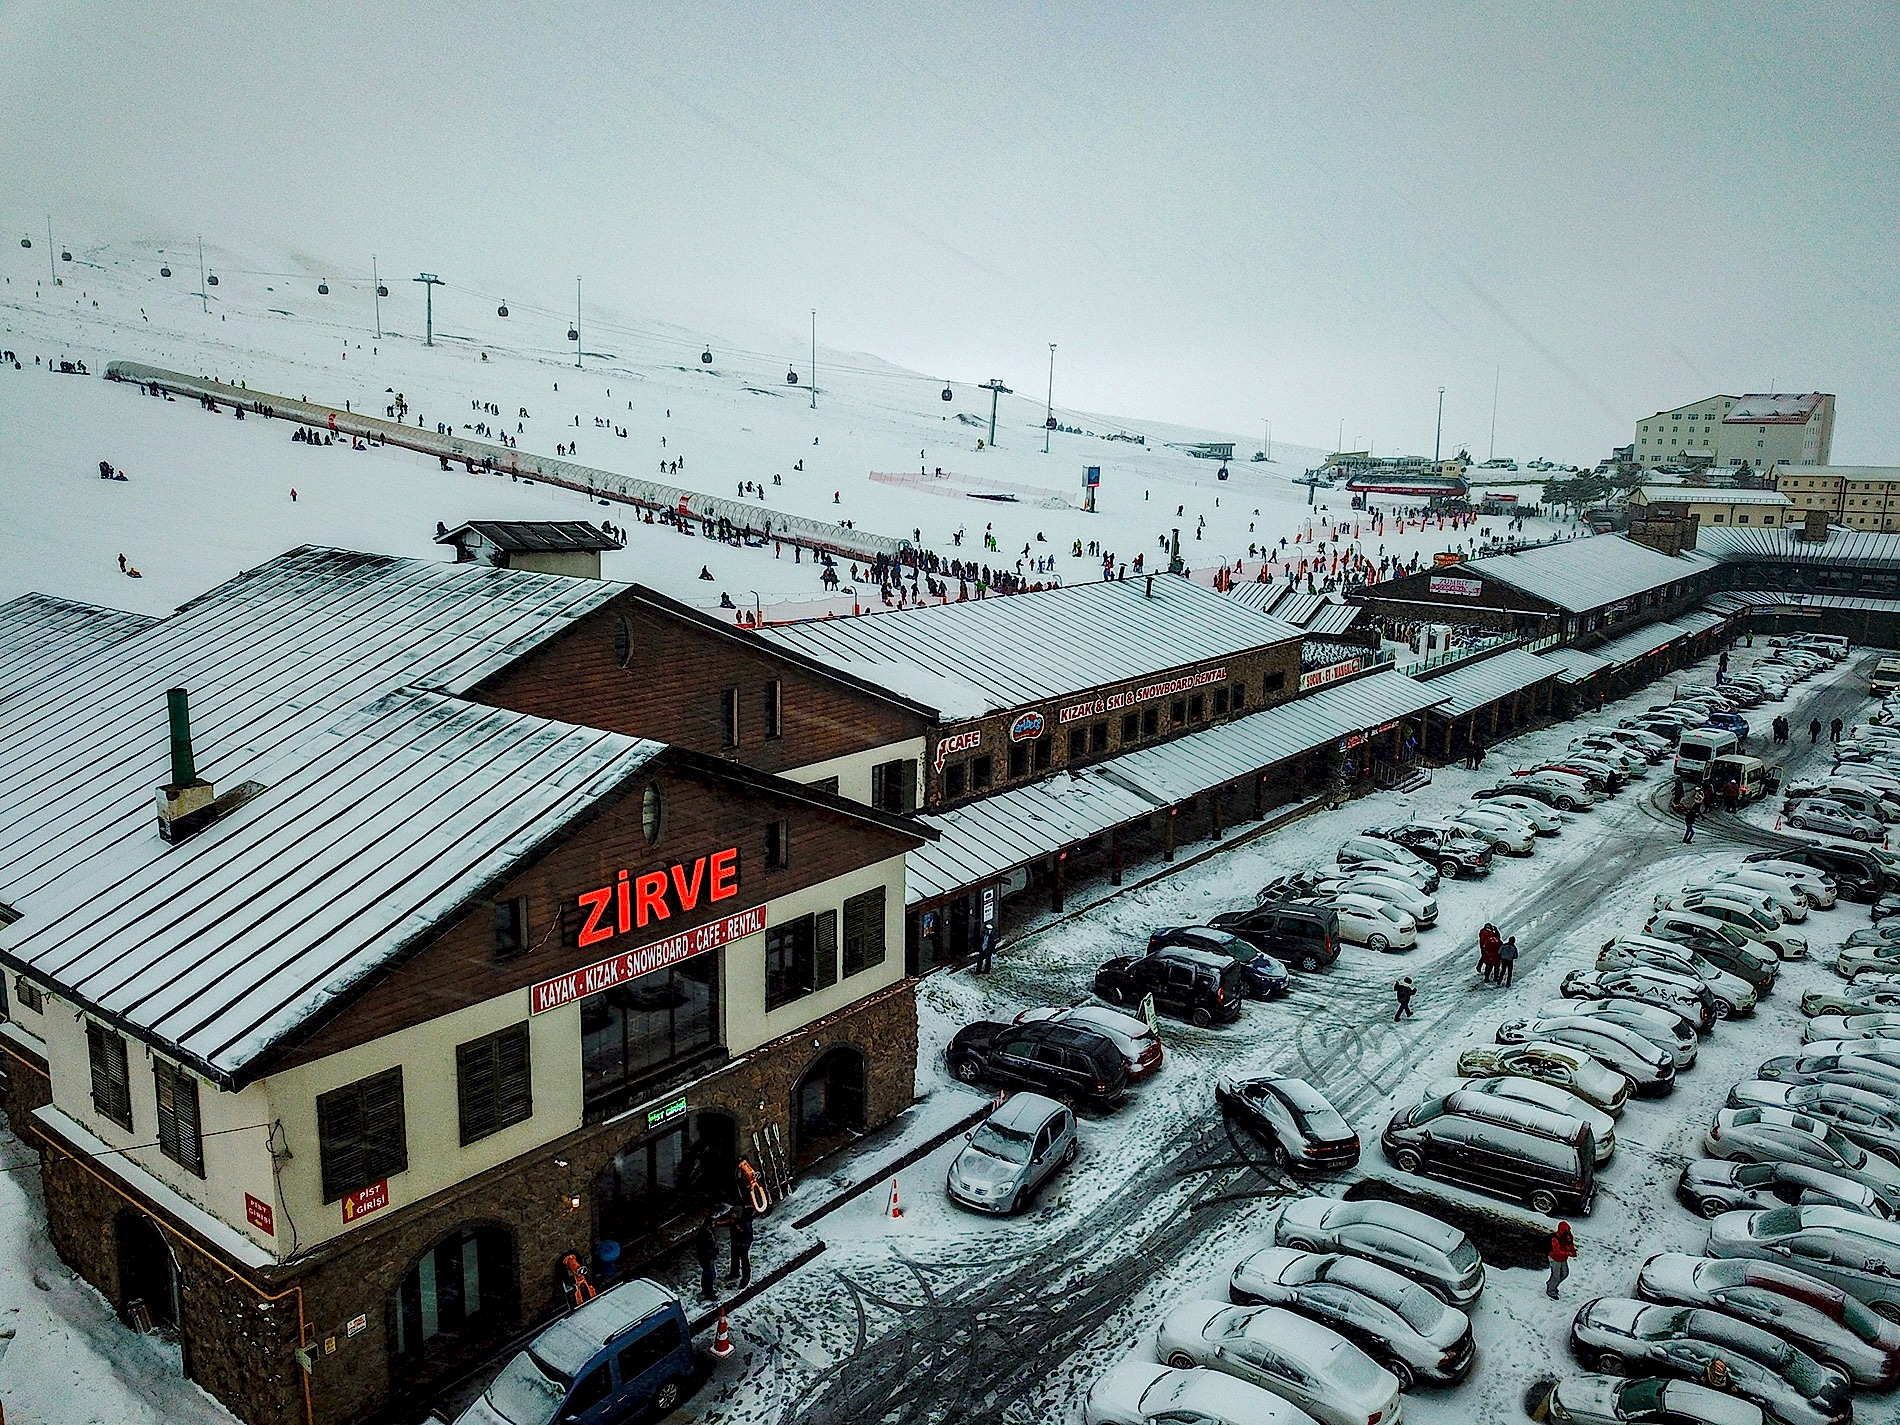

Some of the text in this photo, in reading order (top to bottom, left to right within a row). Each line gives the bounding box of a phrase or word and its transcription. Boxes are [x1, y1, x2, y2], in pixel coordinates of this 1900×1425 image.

[1060, 701, 1094, 723] KIZAK
[1107, 692, 1124, 710] SKI
[1126, 691, 1135, 705] &
[1137, 676, 1193, 701] SNOWBOARD
[1194, 667, 1228, 686] RENTAL
[948, 731, 980, 752] CAFE
[578, 847, 738, 948] ZİRVE
[540, 911, 761, 1010] KAYAK KIZAK SNOWBOARD CAFE RENTAL
[357, 1194, 385, 1214] GİRİŞİ
[360, 1184, 380, 1200] PİST
